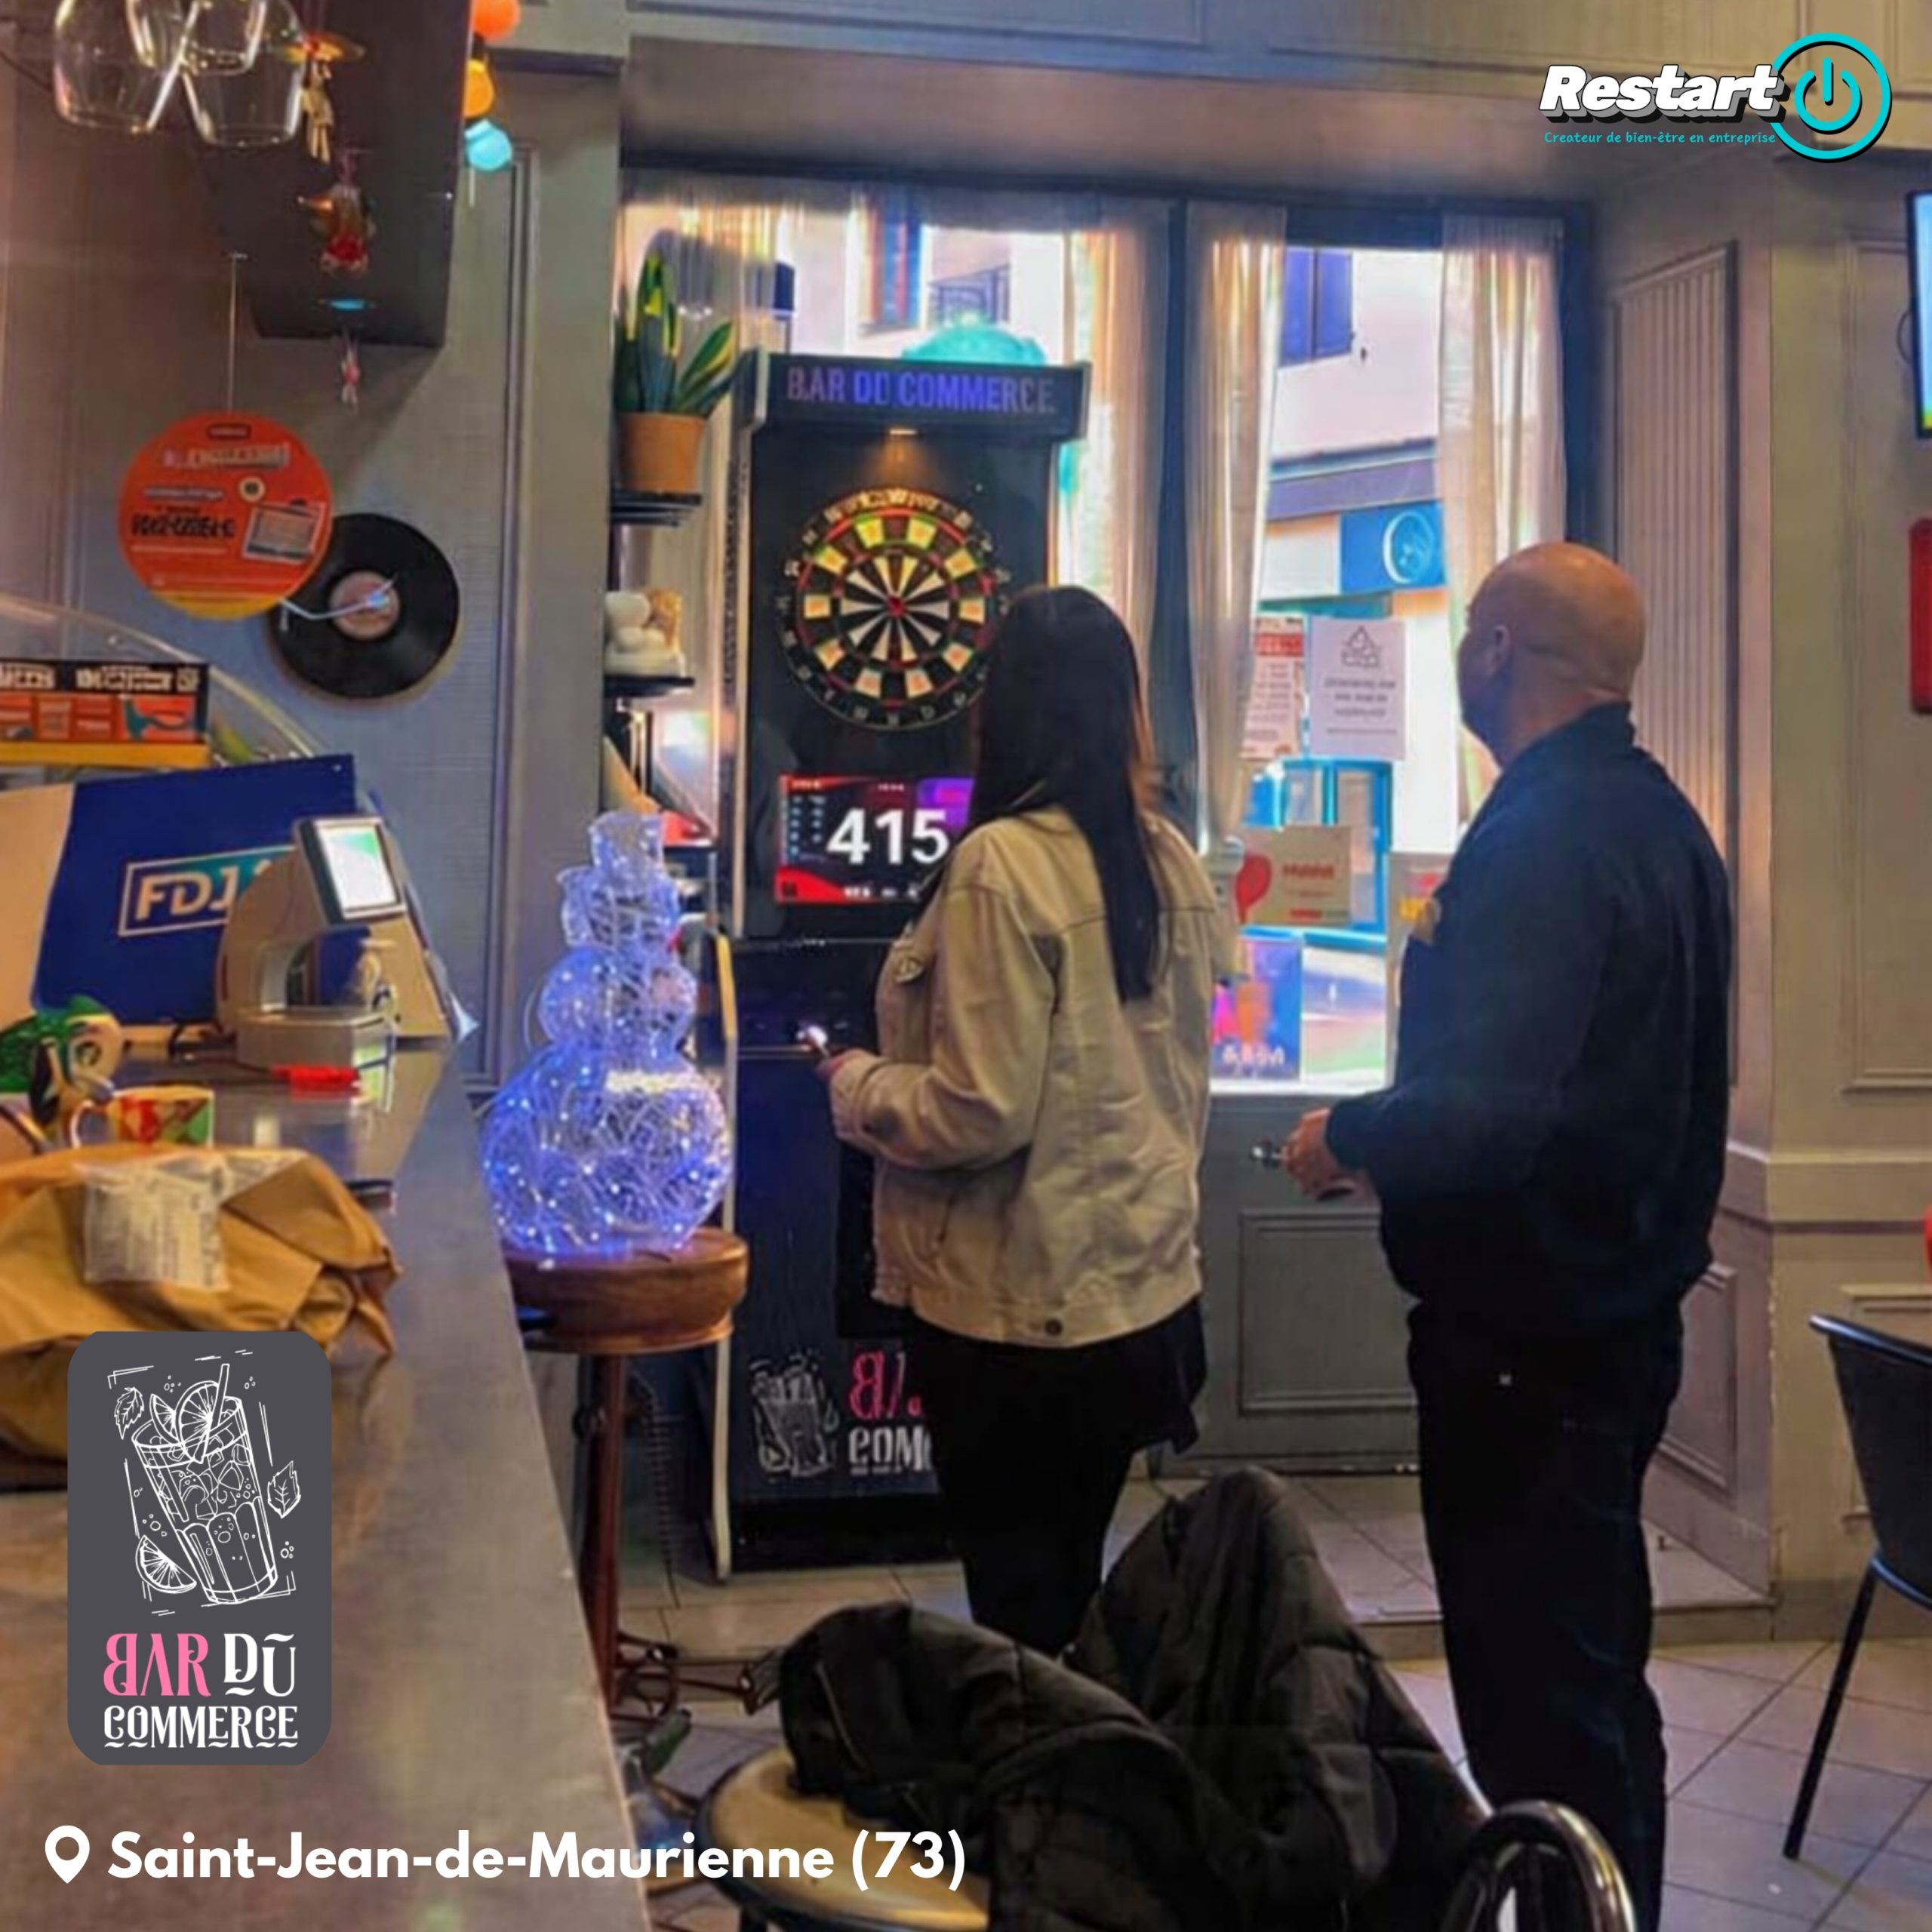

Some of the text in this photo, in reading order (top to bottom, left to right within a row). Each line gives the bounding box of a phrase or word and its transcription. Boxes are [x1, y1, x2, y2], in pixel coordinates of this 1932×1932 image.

[787, 366, 1056, 414] BAR DU COMMERCE
[826, 807, 949, 865] 415
[135, 866, 238, 921] FDJ
